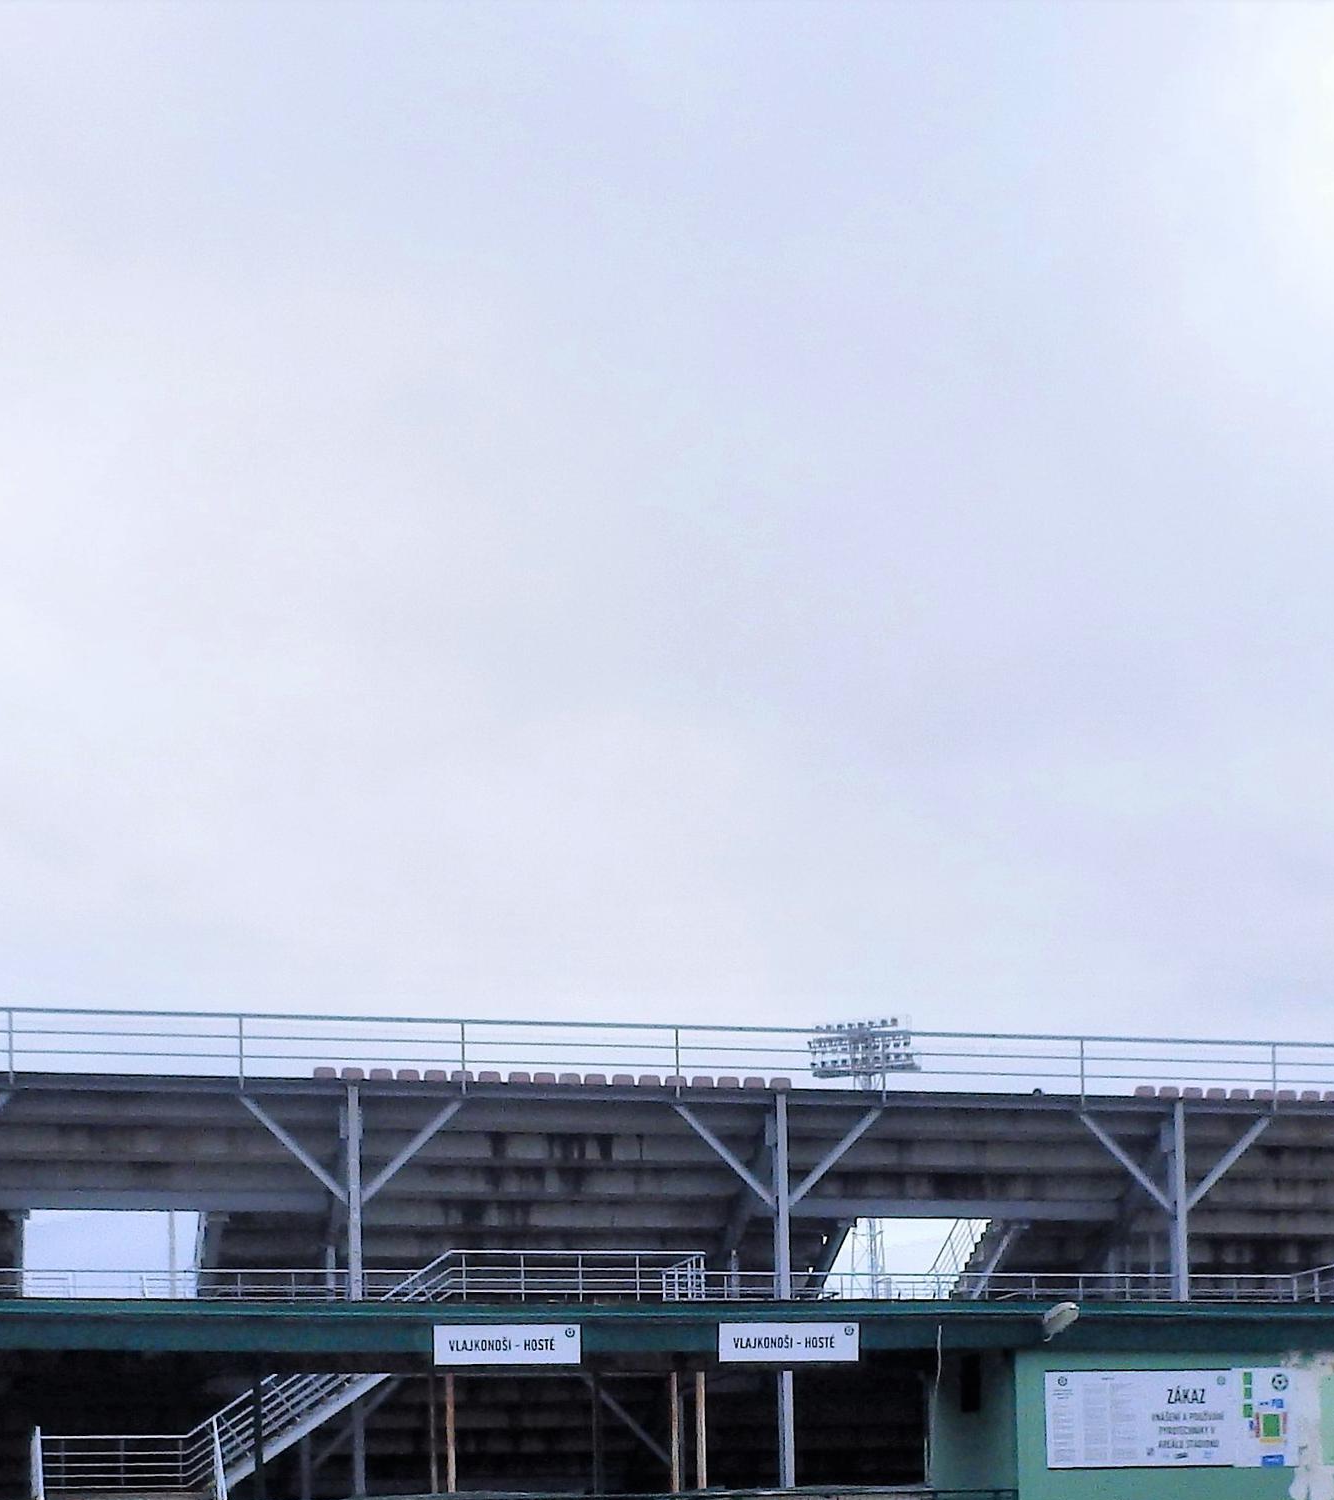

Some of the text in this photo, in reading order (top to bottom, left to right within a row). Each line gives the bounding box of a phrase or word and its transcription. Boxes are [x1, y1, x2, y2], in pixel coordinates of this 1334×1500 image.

[449, 1337, 512, 1352] VLAJKONOŠI
[524, 1336, 555, 1351] HOSTÉ
[733, 1335, 793, 1349] VLAJKONOŠI
[804, 1335, 835, 1349] HOSTÉ
[1167, 1385, 1206, 1404] ZÁKAZ
